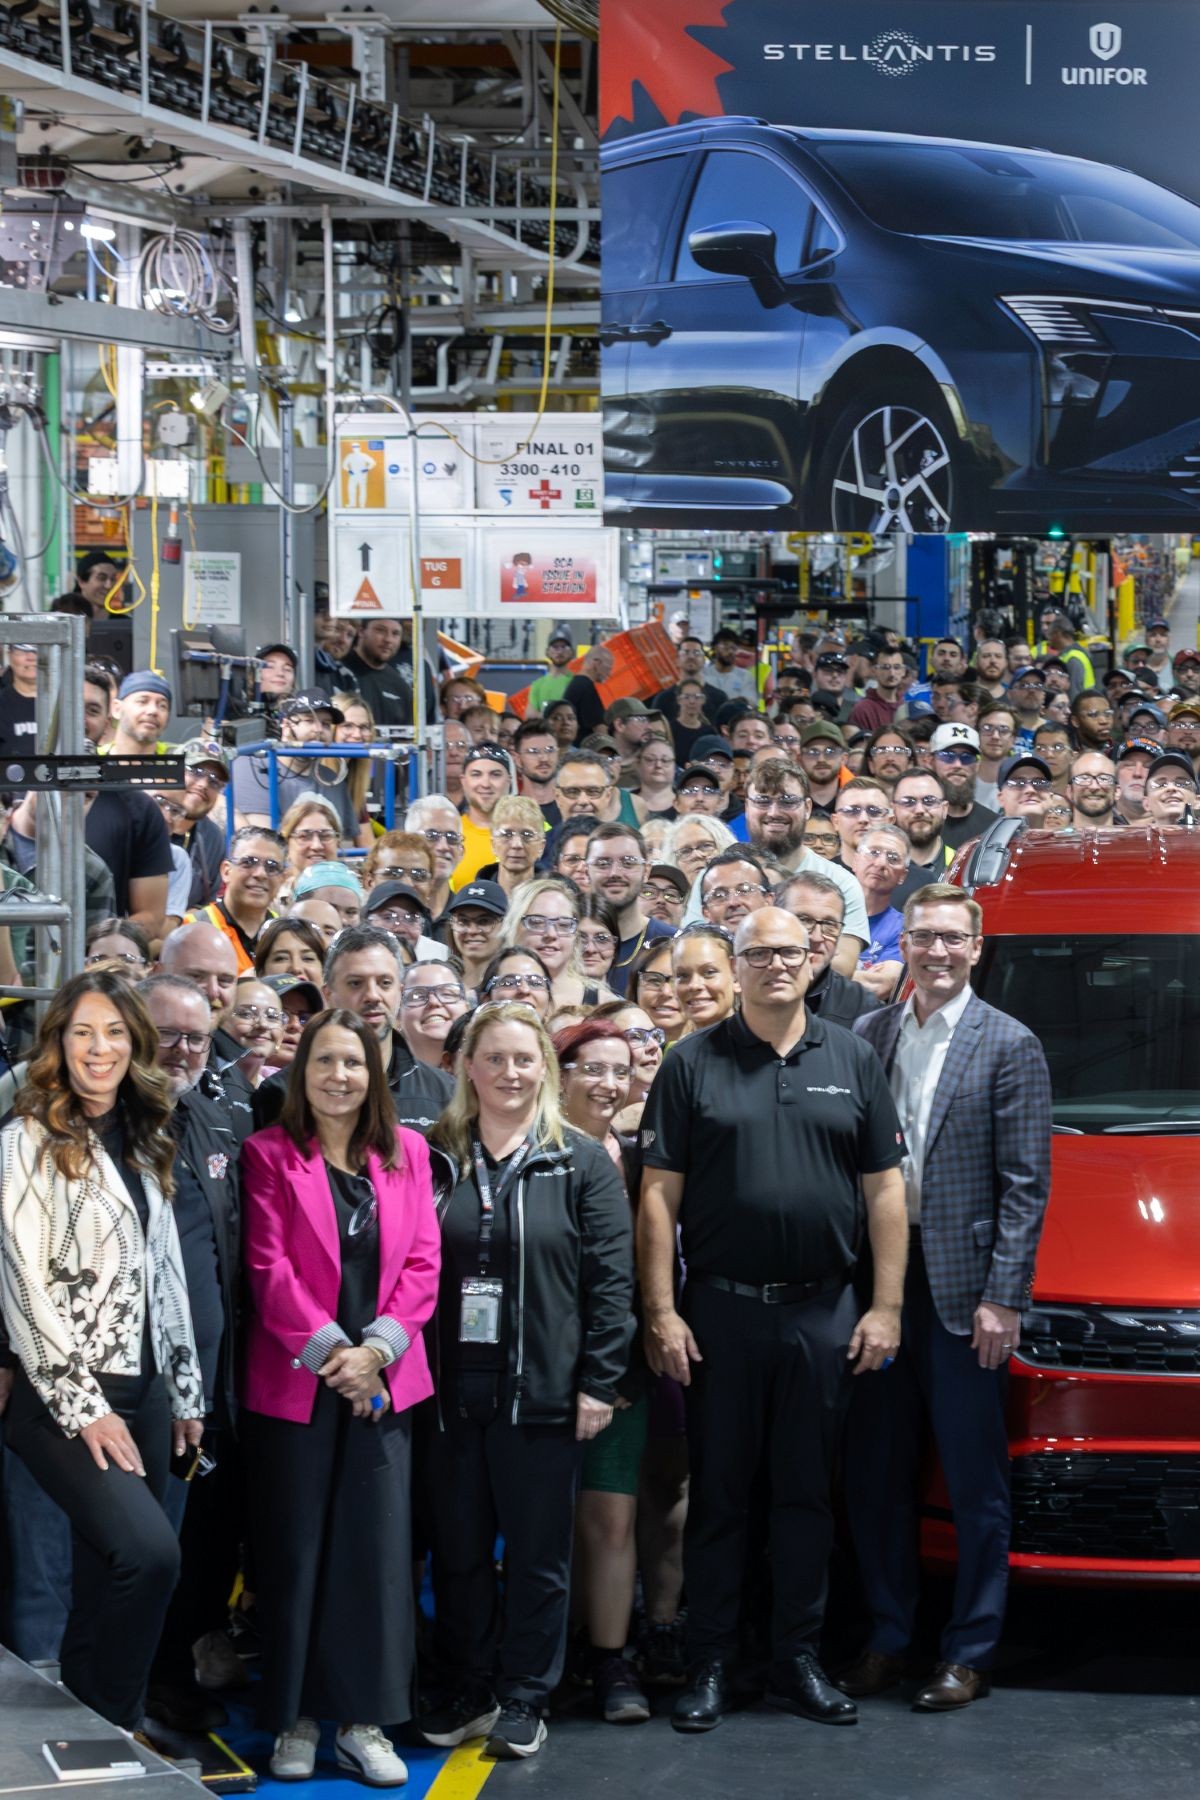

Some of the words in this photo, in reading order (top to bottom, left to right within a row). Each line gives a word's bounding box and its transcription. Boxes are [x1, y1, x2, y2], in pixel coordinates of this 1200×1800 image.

[763, 44, 997, 62] STELLANTIS
[517, 442, 569, 455] FINAL
[575, 443, 594, 455] 01
[500, 463, 581, 476] 3300-410
[424, 561, 448, 572] TUG
[431, 577, 441, 586] G
[572, 570, 585, 582] IN
[542, 582, 586, 594] STATION
[951, 726, 969, 739] M
